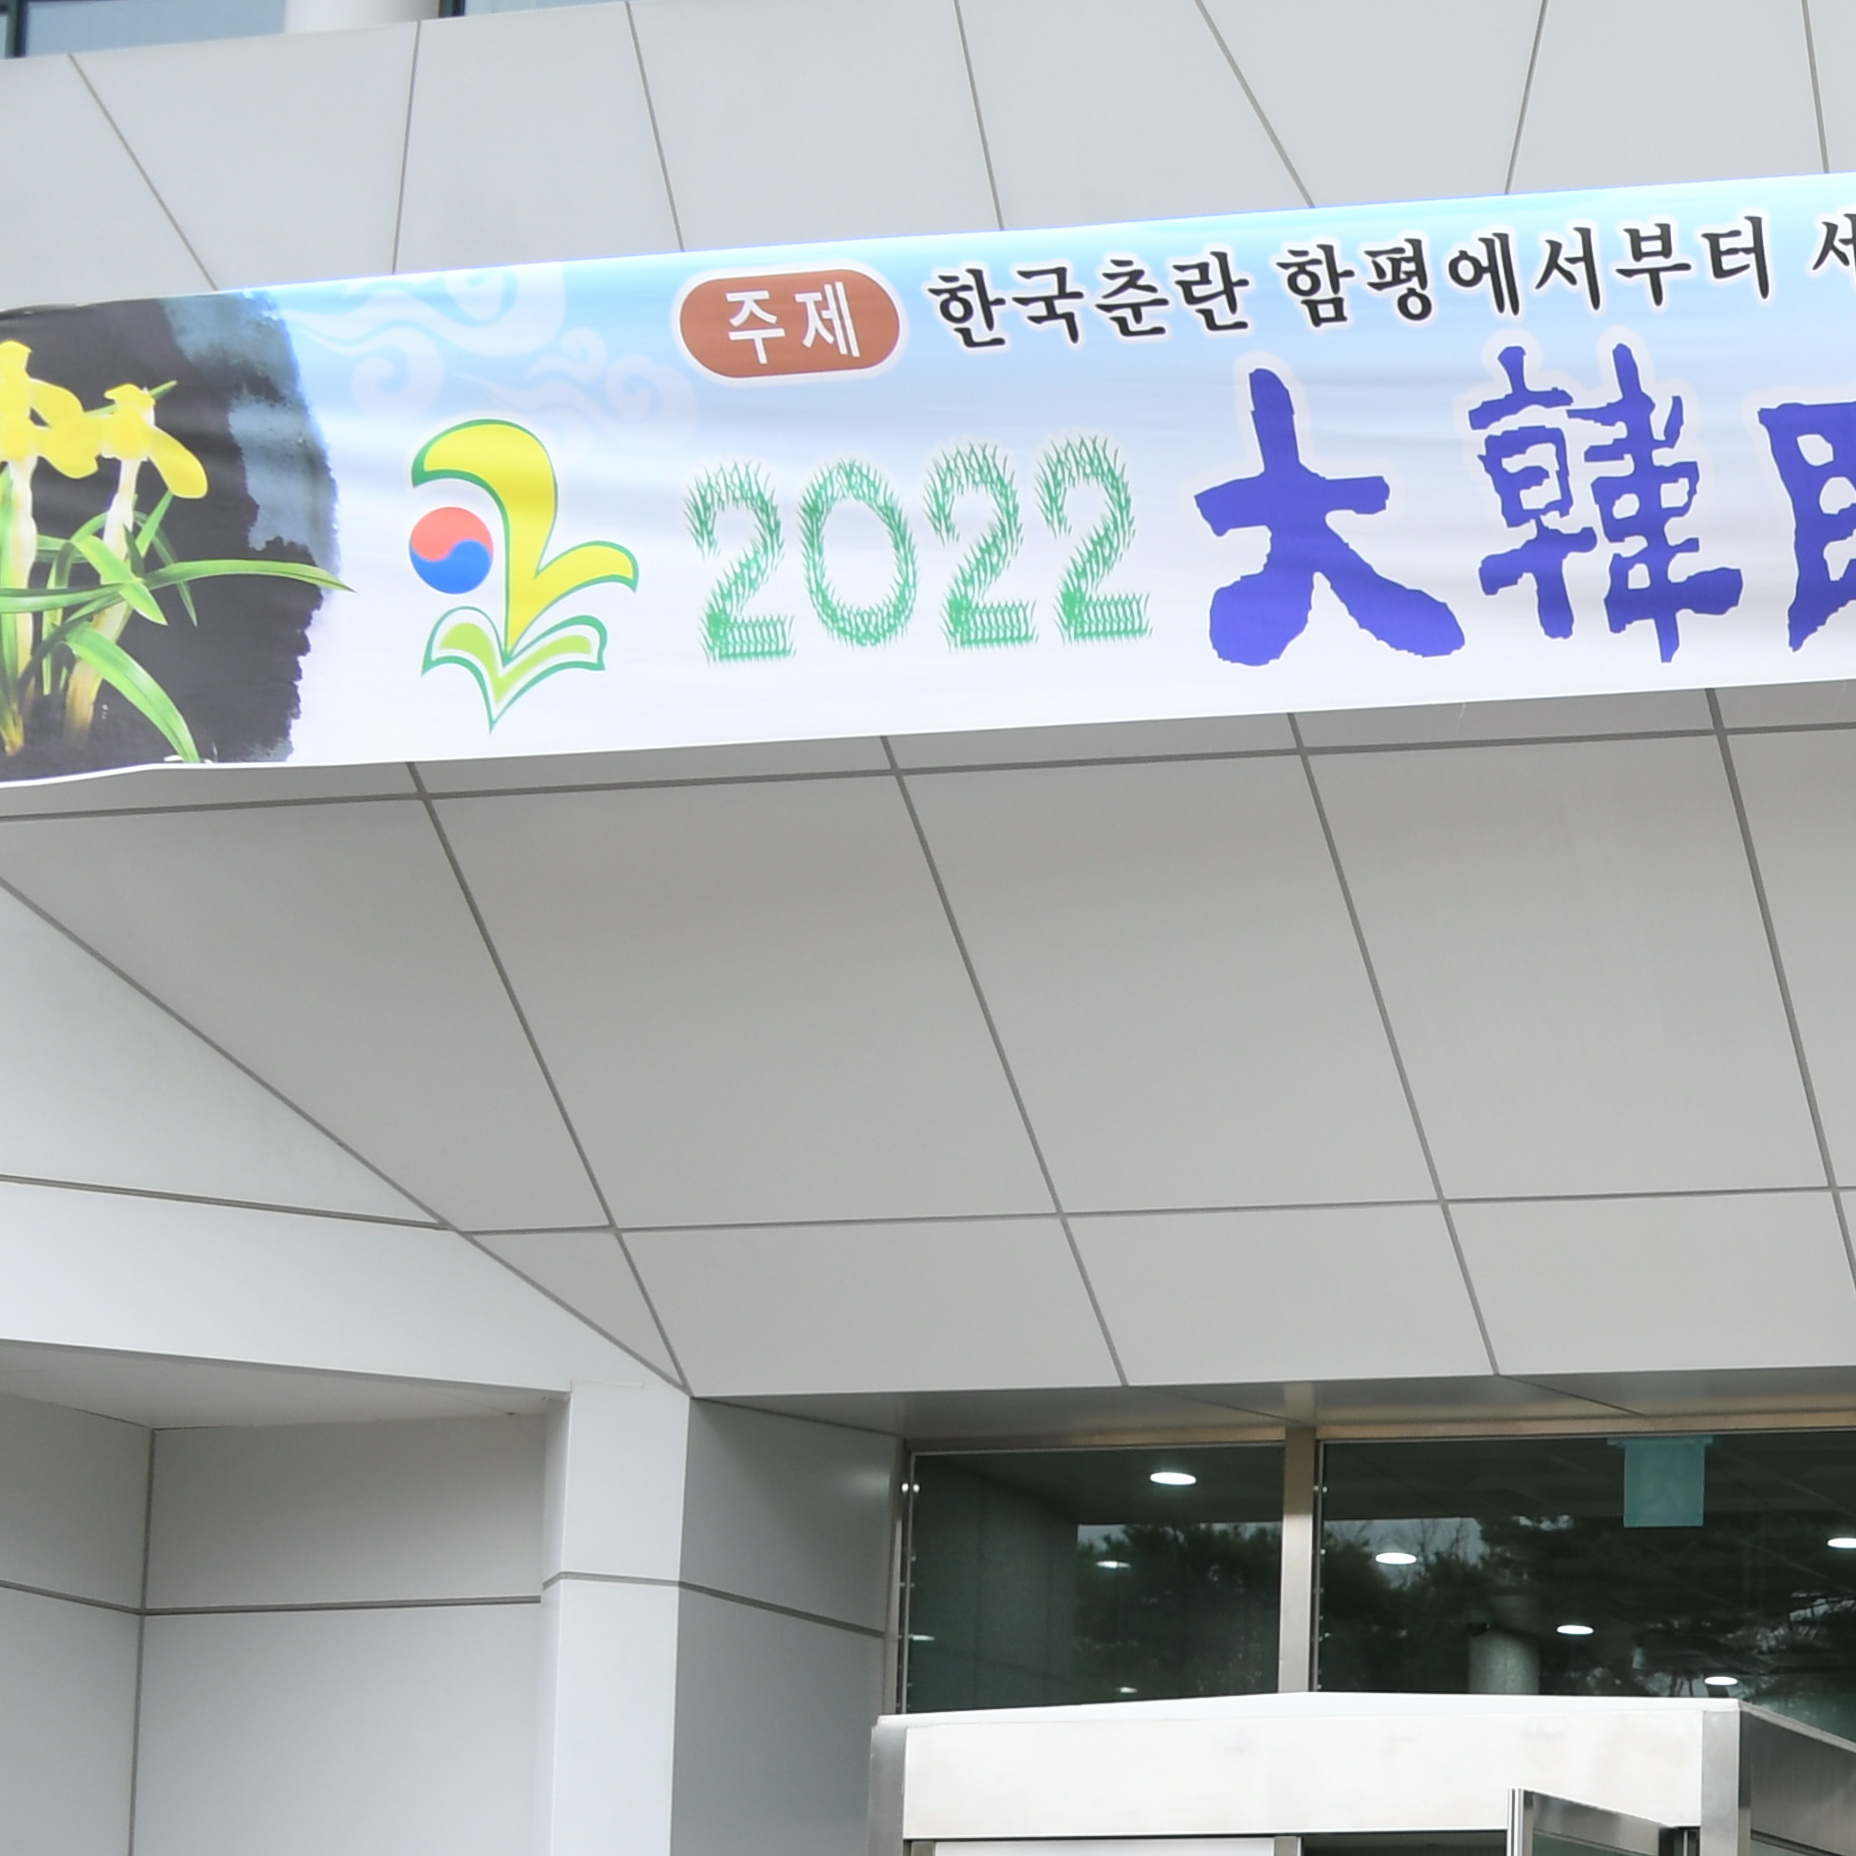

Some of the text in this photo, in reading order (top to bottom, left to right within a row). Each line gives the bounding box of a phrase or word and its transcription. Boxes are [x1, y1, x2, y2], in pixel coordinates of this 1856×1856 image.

[725, 281, 866, 365] 주제
[928, 251, 1250, 348] 한국춘란
[1276, 215, 1771, 328] 함평에서부터
[680, 432, 1152, 667] 2022
